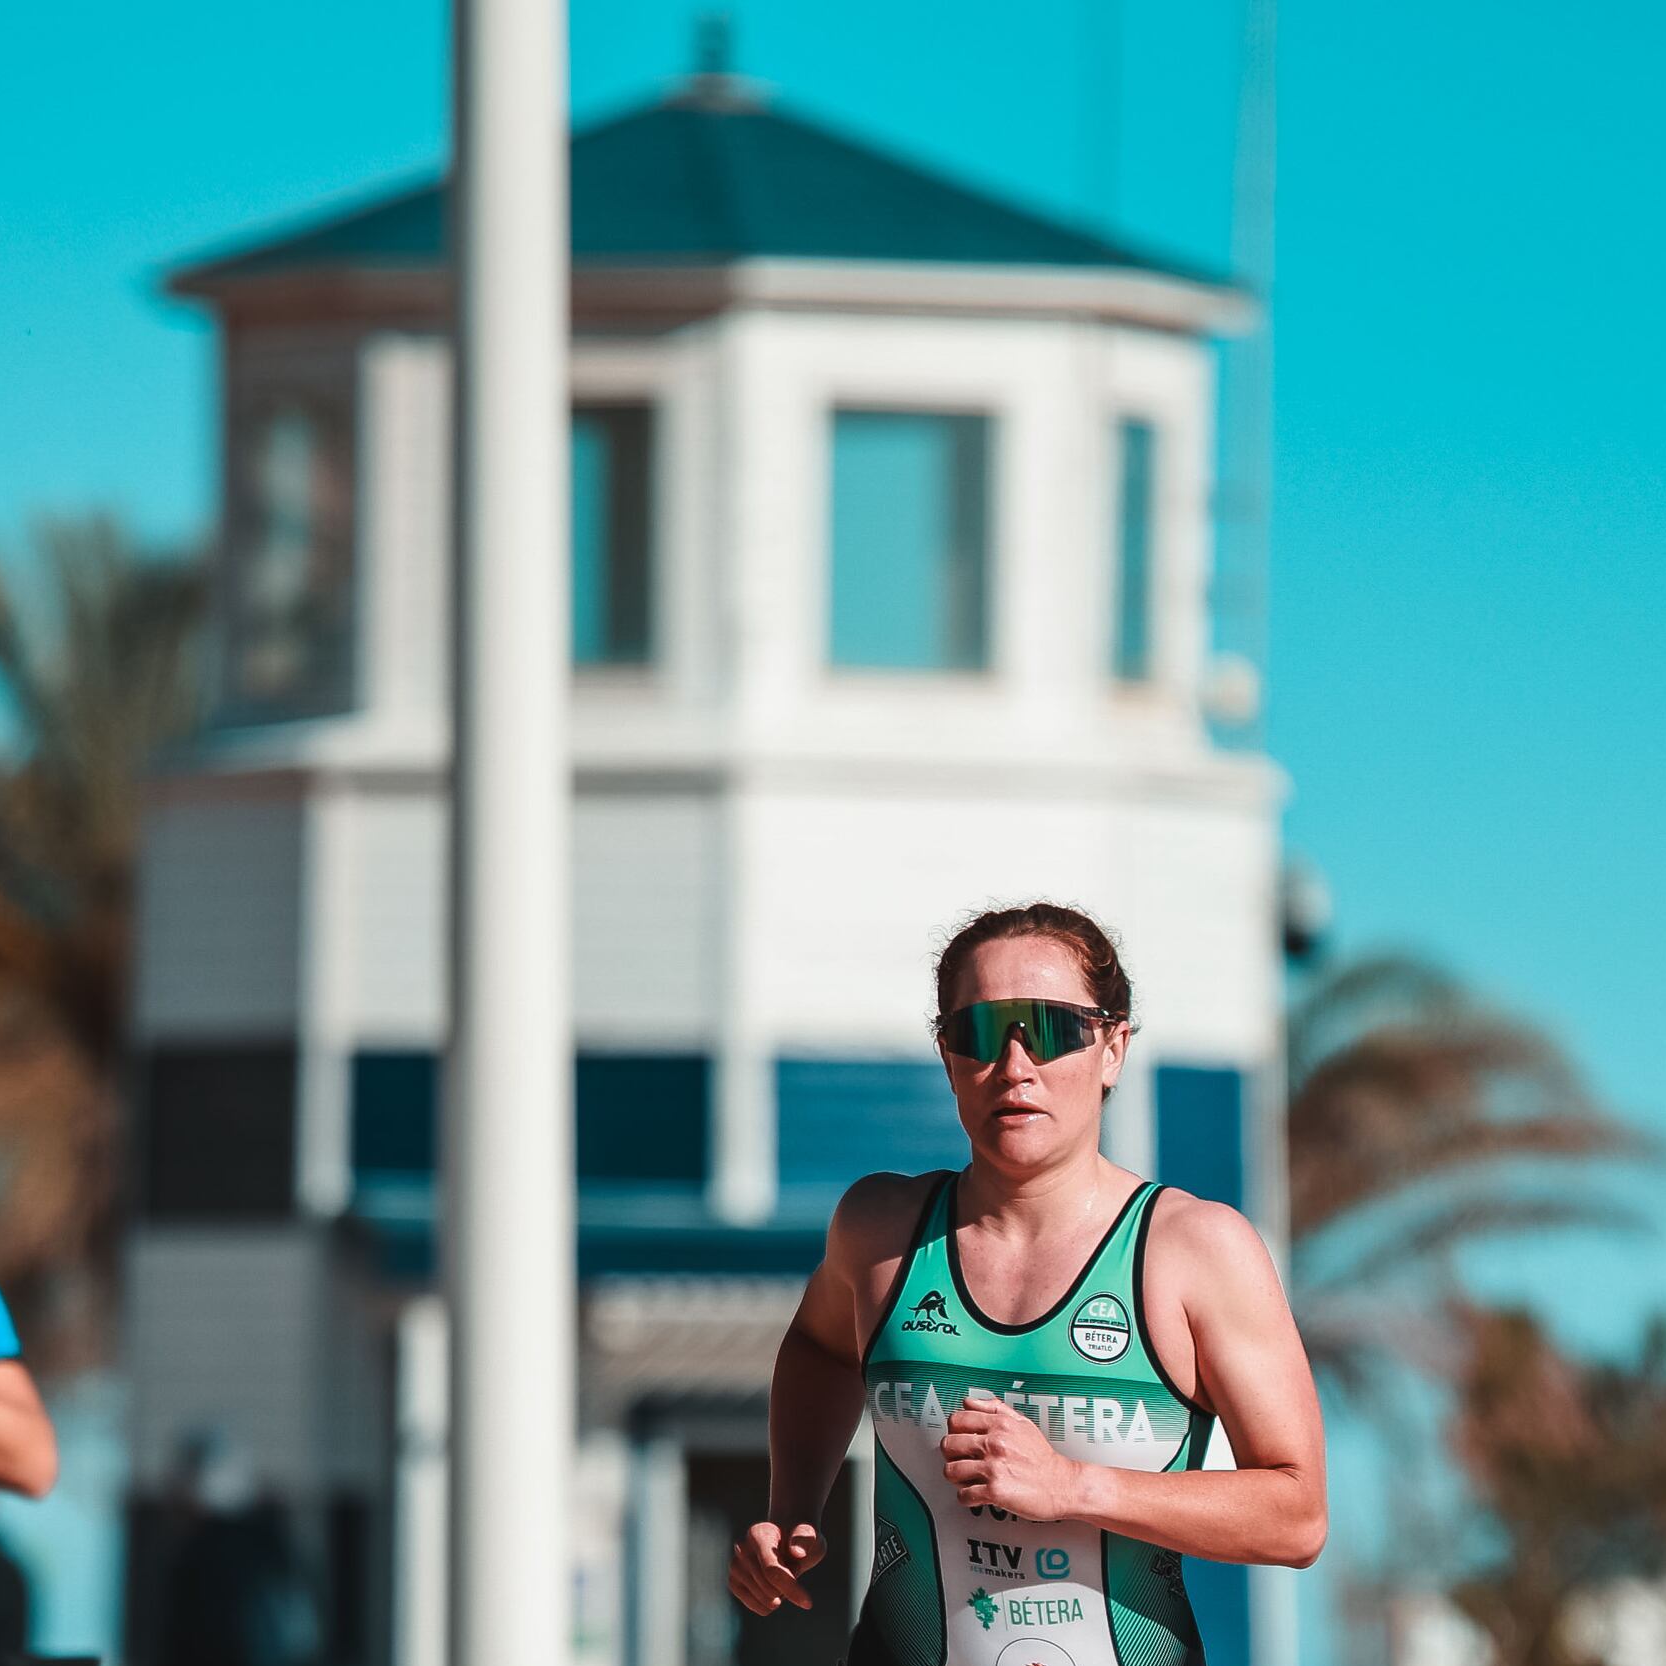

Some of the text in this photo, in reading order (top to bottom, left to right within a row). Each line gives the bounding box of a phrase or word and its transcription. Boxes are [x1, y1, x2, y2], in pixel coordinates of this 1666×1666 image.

[1088, 1302, 1117, 1318] CEA
[1085, 1331, 1118, 1344] BÉTERA
[874, 1381, 1155, 1444] CEA TERA
[967, 1538, 1023, 1570] ITV
[1009, 1596, 1084, 1626] BÉTERA
